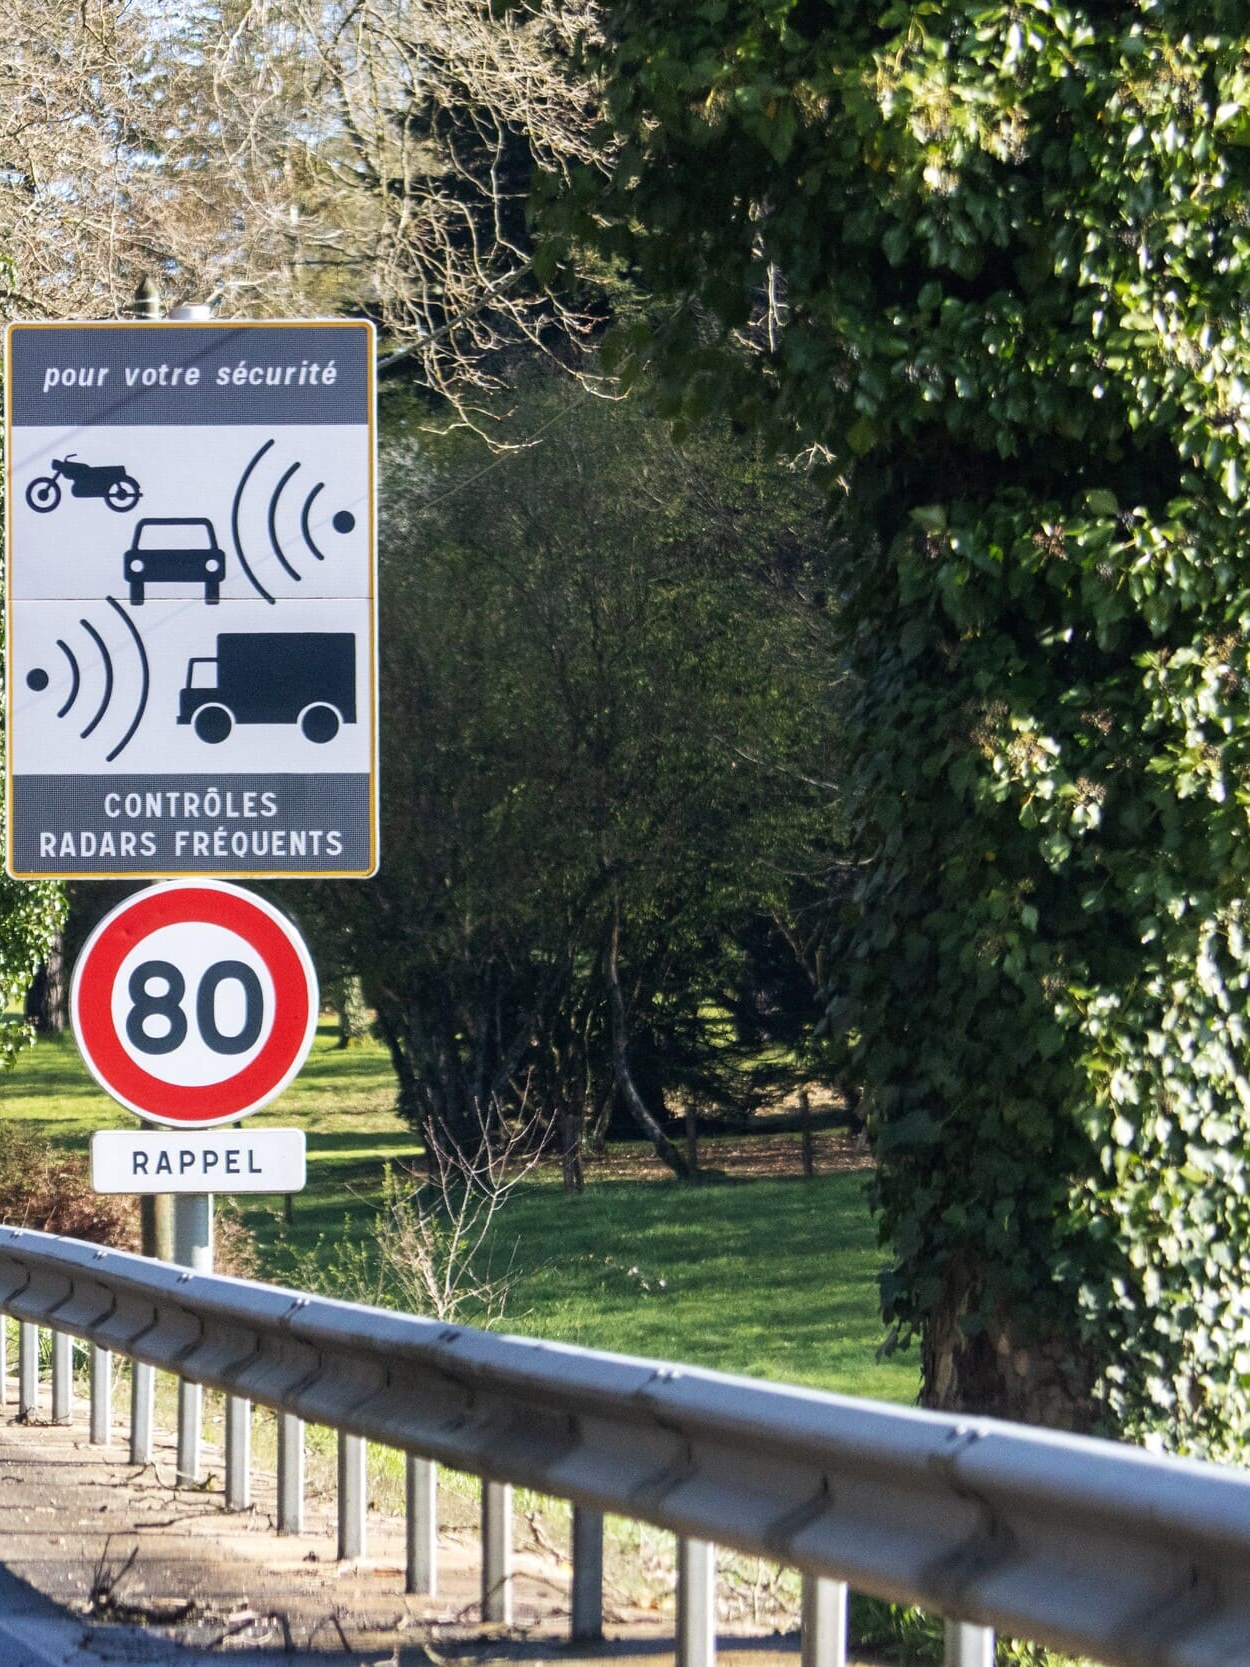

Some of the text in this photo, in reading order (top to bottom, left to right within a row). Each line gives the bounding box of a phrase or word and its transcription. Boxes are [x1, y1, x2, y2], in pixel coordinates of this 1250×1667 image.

[43, 360, 338, 393] pour votre sécurité
[104, 787, 278, 818] CONTRÔLES
[40, 826, 343, 857] RADARS FRÉQUENTS
[126, 960, 264, 1055] 80
[133, 1149, 262, 1175] RAPPEL
